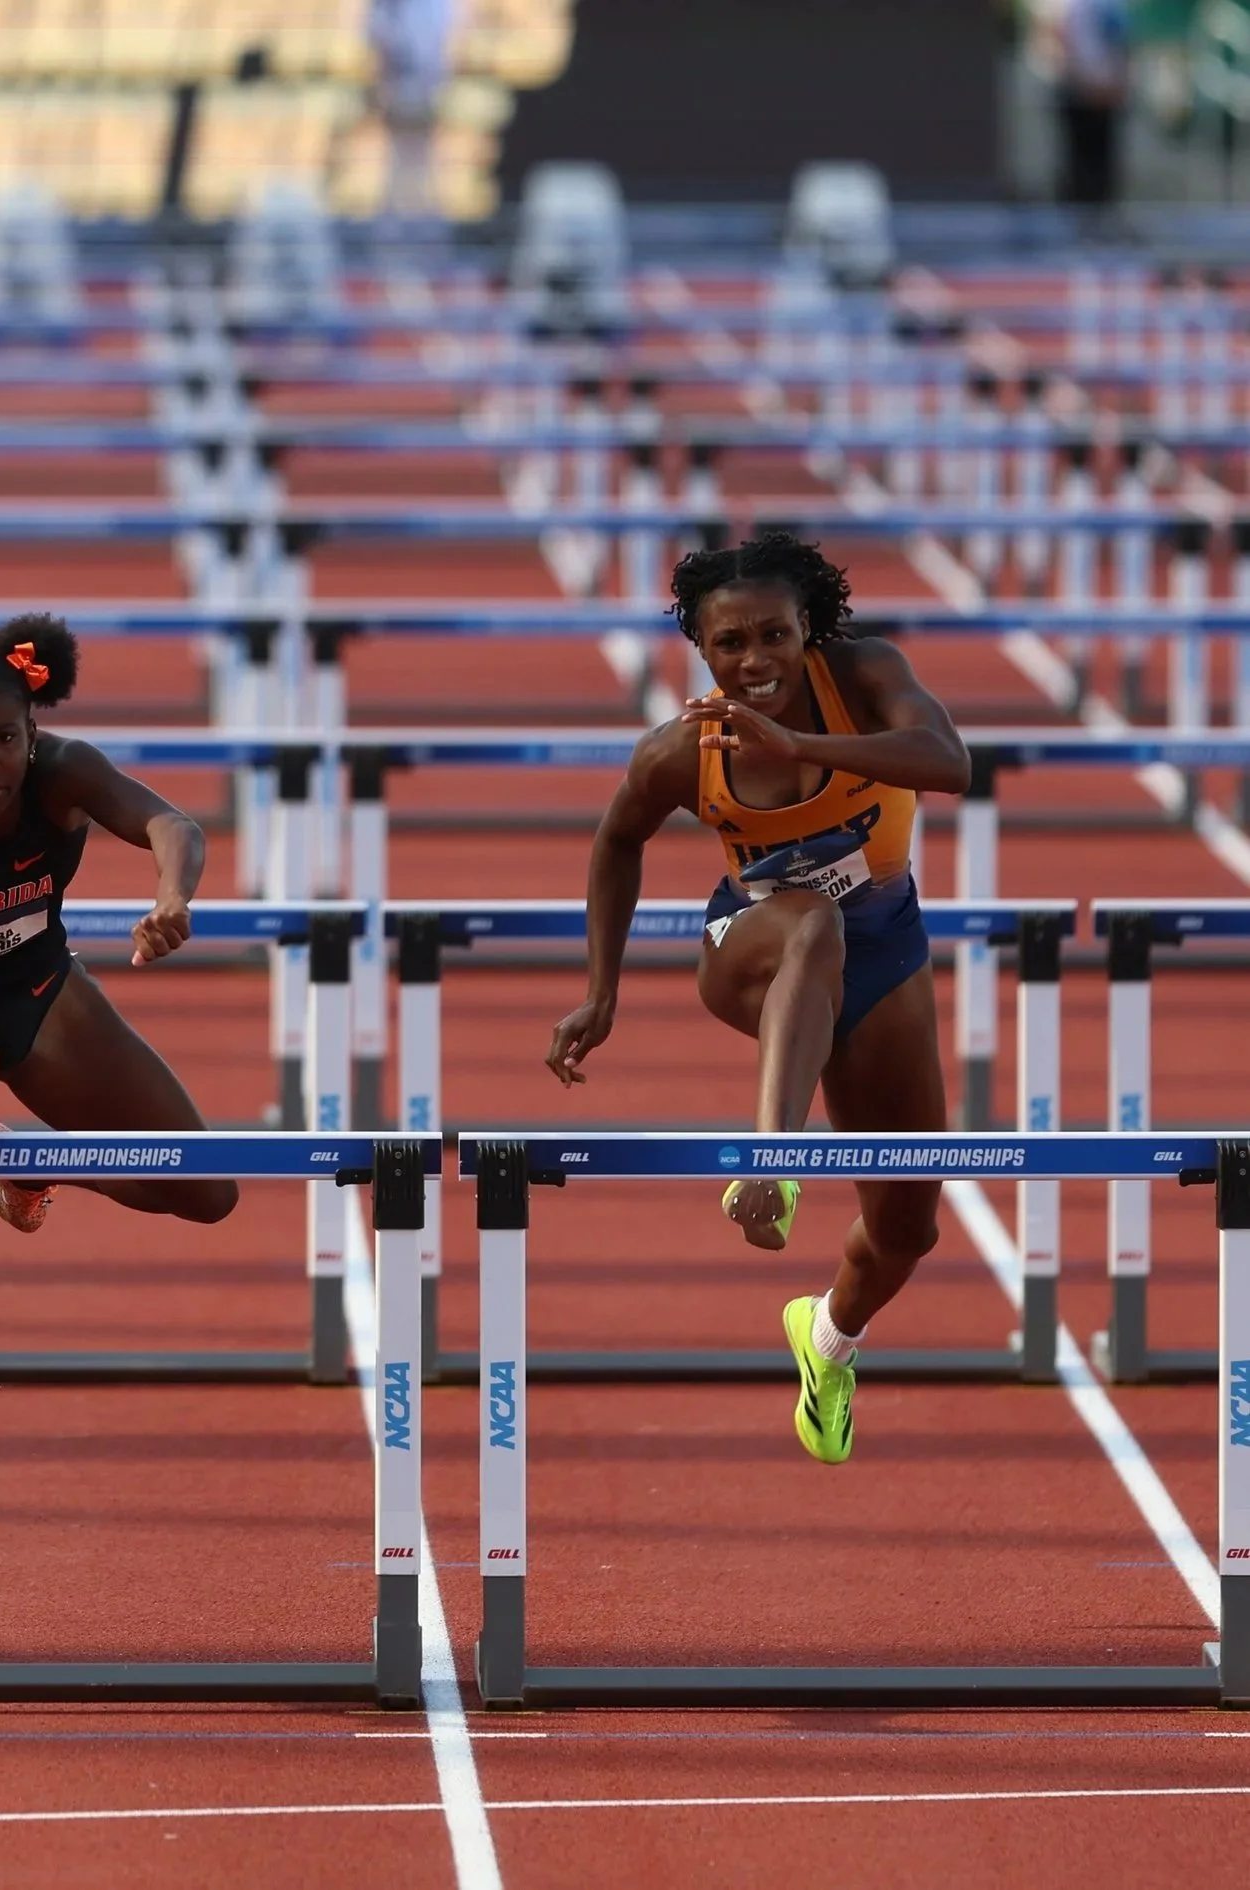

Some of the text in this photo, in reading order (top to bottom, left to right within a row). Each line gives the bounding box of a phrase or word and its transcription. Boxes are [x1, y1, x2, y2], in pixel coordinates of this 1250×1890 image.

[34, 1148, 183, 1167] CHAMPIONSHIPS
[310, 1151, 340, 1162] GILL
[560, 1152, 590, 1162] GILL
[752, 1148, 1026, 1167] TRACK & FIELD CHAMPIONSHIPS
[1153, 1151, 1183, 1161] GILL
[383, 1361, 412, 1451] NCAA
[488, 1360, 517, 1451] NCAA
[382, 1547, 415, 1558] GILL
[487, 1548, 520, 1559] GILL
[1226, 1548, 1250, 1558] GIL
